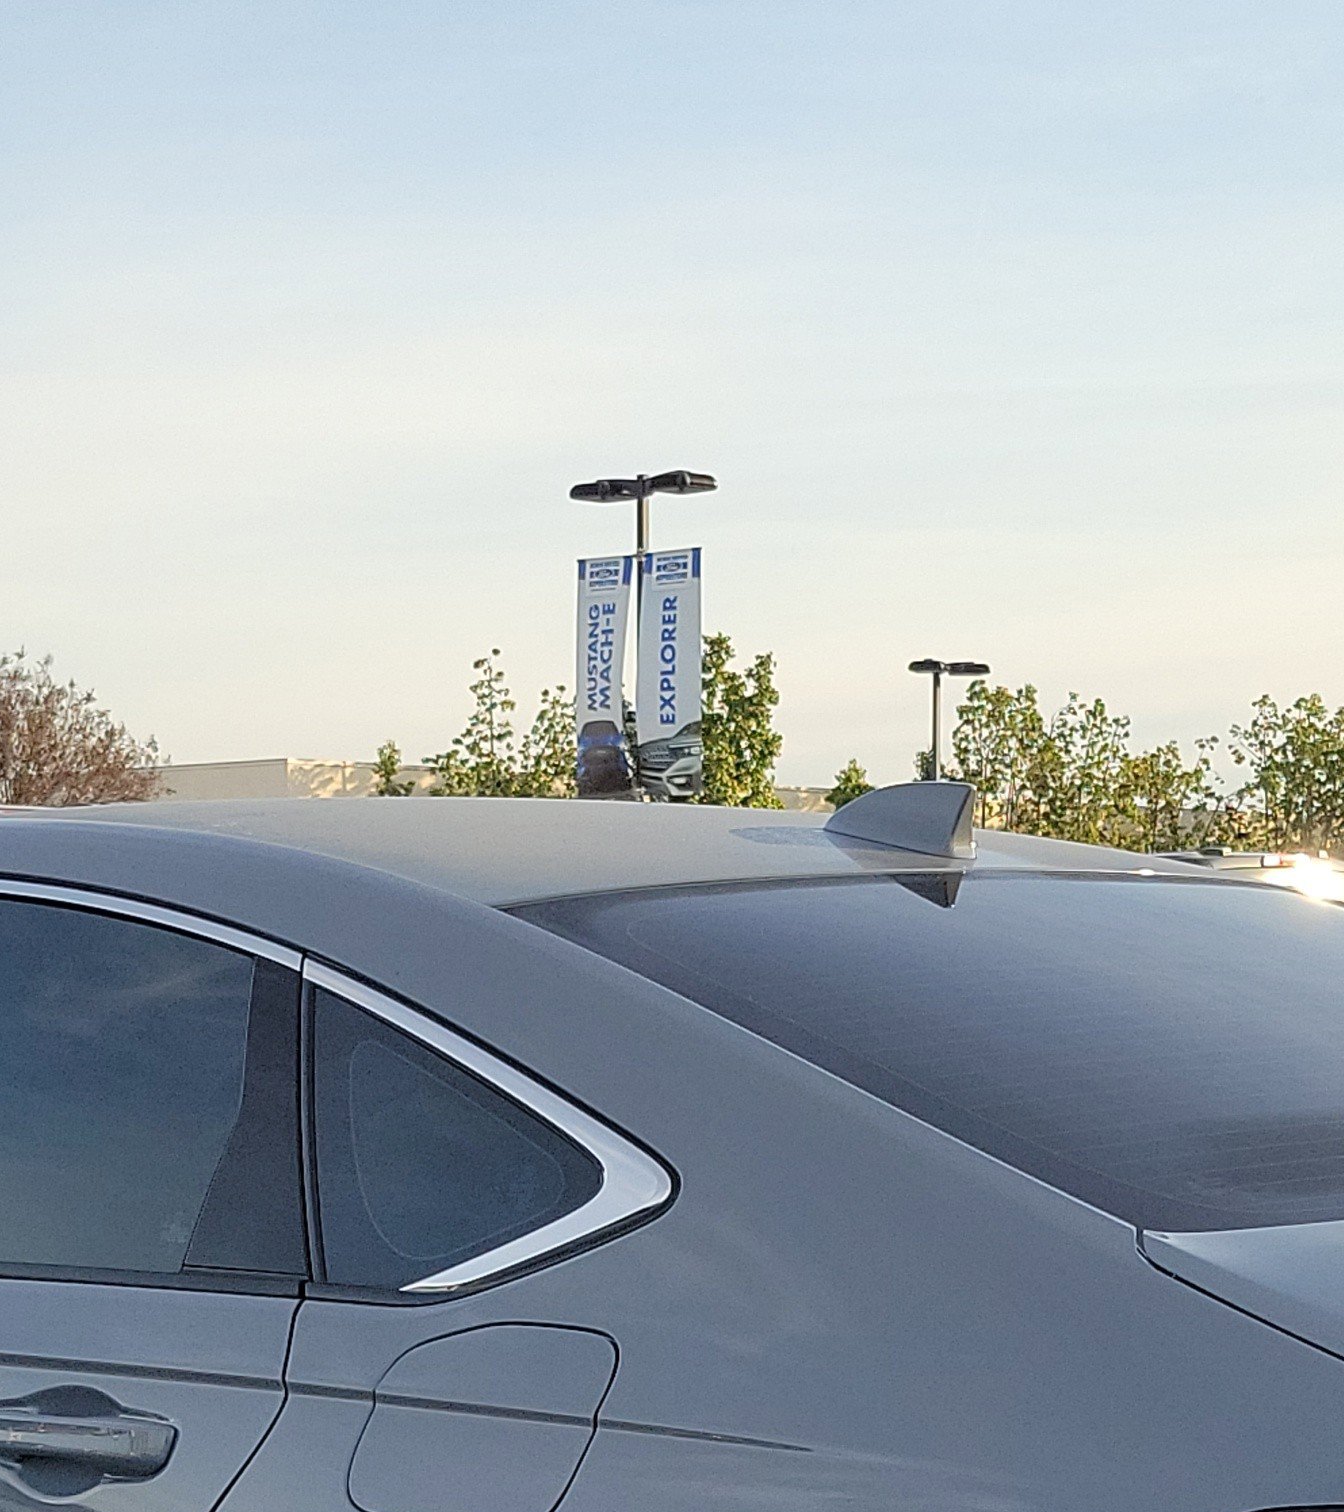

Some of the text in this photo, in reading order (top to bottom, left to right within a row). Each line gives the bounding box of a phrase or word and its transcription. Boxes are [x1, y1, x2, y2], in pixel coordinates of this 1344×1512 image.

[587, 603, 601, 712] MUSTANG
[599, 602, 617, 710] MACH-E
[660, 595, 679, 725] EXPLORER
